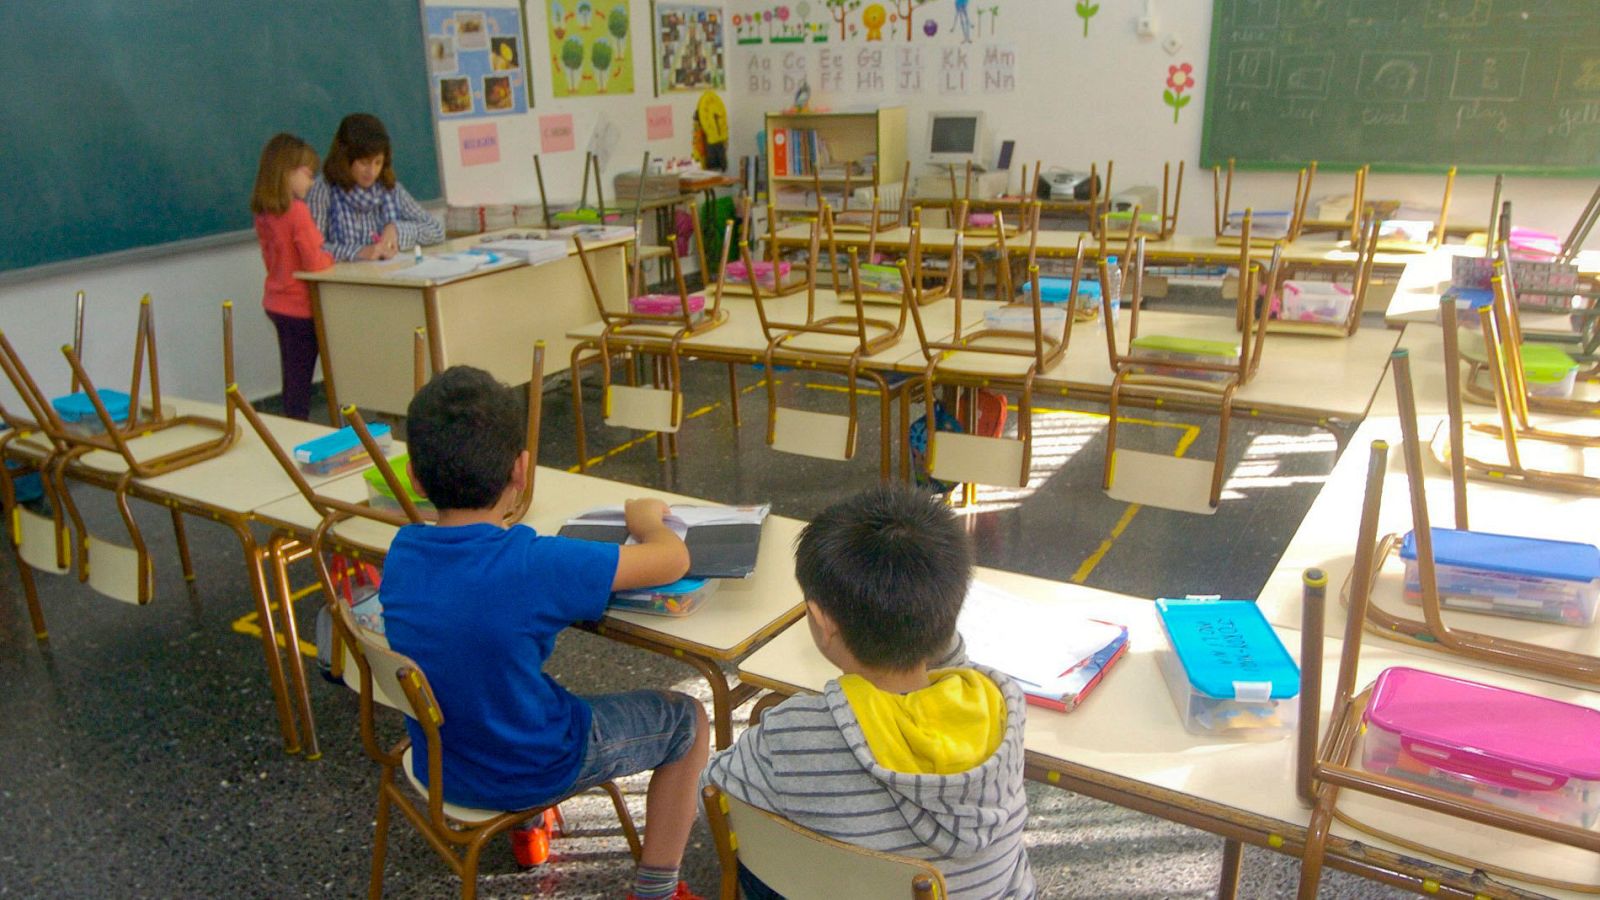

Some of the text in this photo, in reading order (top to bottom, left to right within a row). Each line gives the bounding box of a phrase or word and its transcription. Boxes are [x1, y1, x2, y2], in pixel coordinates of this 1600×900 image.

[748, 46, 1015, 70] Aa Cc Ee Gg Ii Kk Mm
[749, 75, 772, 92] Bb
[820, 71, 842, 90] Ff
[857, 71, 884, 90] Hh
[901, 70, 920, 90] Jj
[945, 71, 964, 90] Ll
[984, 70, 1015, 90] Nn
